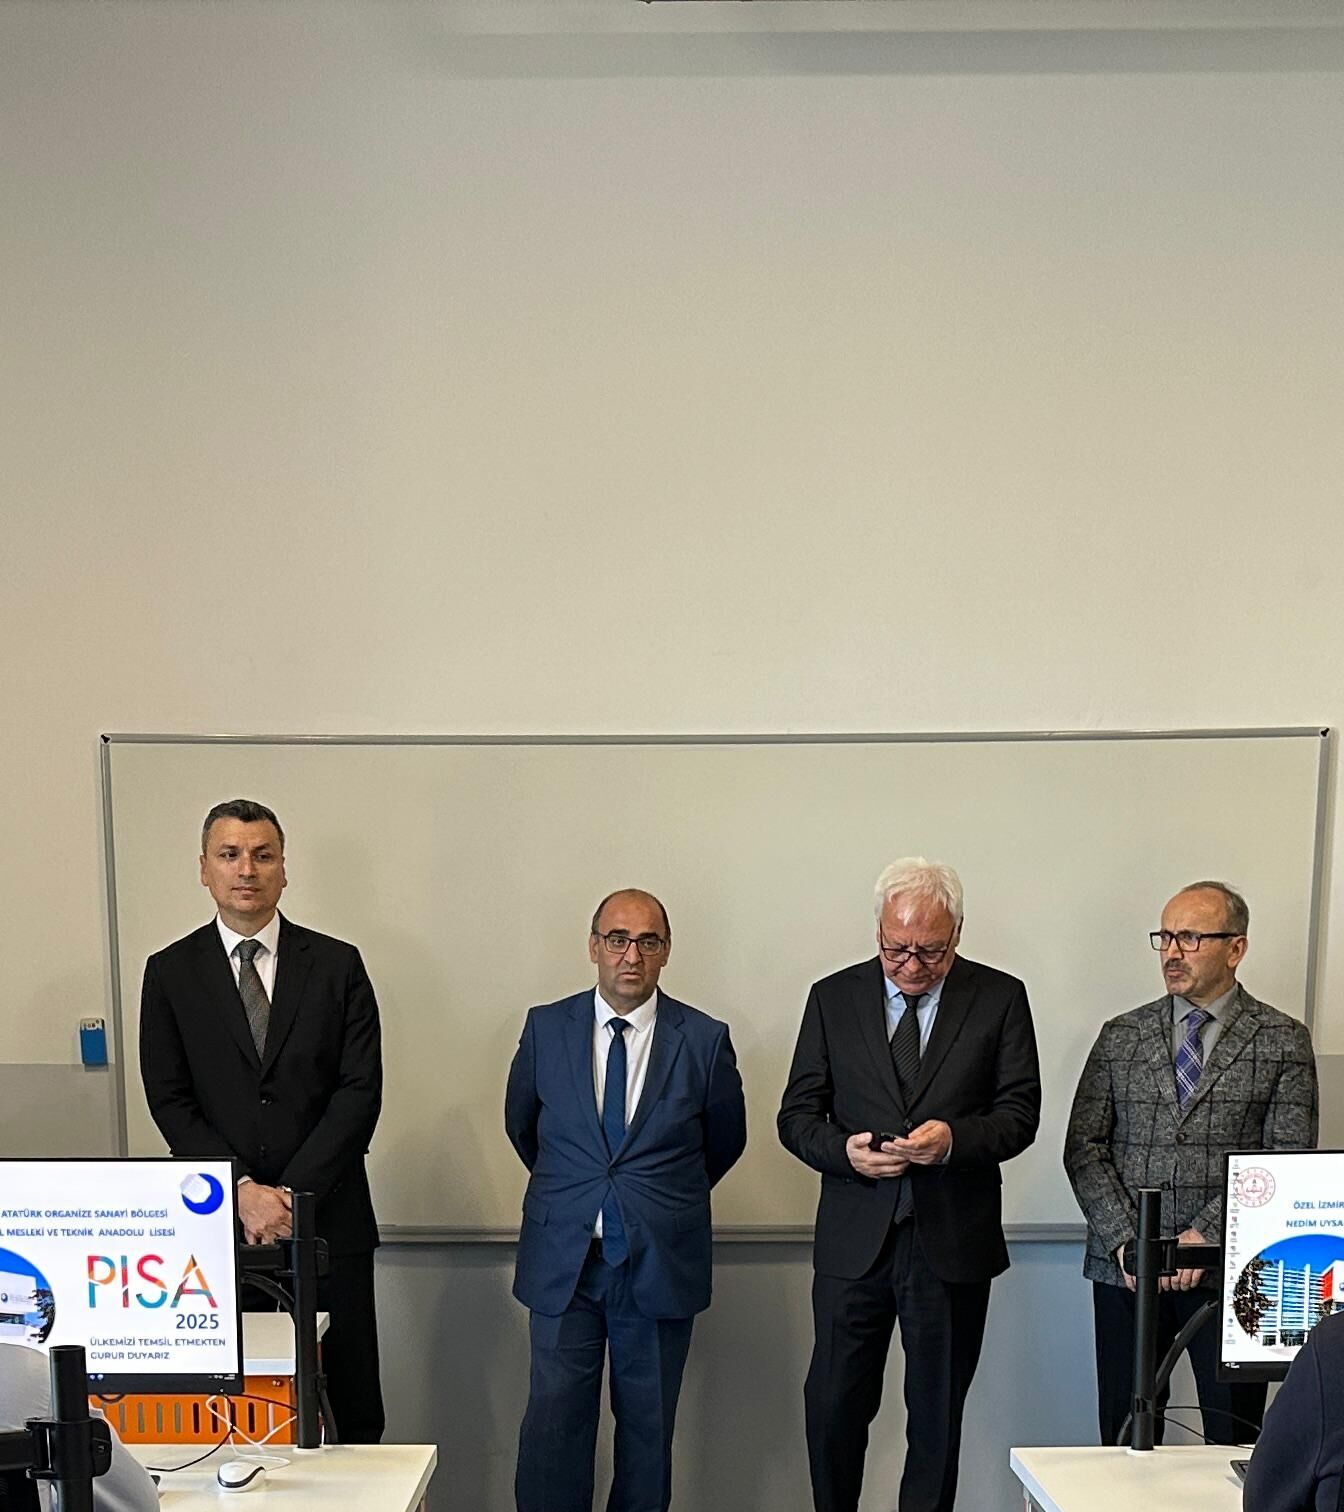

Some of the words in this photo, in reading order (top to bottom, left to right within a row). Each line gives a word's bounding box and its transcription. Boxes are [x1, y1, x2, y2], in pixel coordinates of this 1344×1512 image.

[1293, 1200, 1315, 1209] ÖZEL
[1318, 1200, 1344, 1209] İZMİR
[1, 1208, 42, 1218] ATATÜRK
[45, 1208, 93, 1218] ORGANİZE
[94, 1208, 128, 1218] SANAYİ
[131, 1207, 168, 1218] BÖLGESİ
[1286, 1219, 1317, 1228] NEDİM
[7, 1227, 44, 1237] MESLEKİ
[47, 1228, 58, 1237] VE
[61, 1227, 93, 1237] TEKNİK
[98, 1228, 144, 1237] ANADOLU
[150, 1227, 175, 1237] LİSESİ
[87, 1253, 218, 1308] PISA
[175, 1313, 219, 1329] 2025
[90, 1337, 135, 1346] ÜLKEMİZİ
[138, 1337, 172, 1346] TEMSİL
[175, 1338, 226, 1346] ETMEKTEN
[90, 1352, 124, 1360] GURUR
[127, 1352, 170, 1360] DUYARIZ
